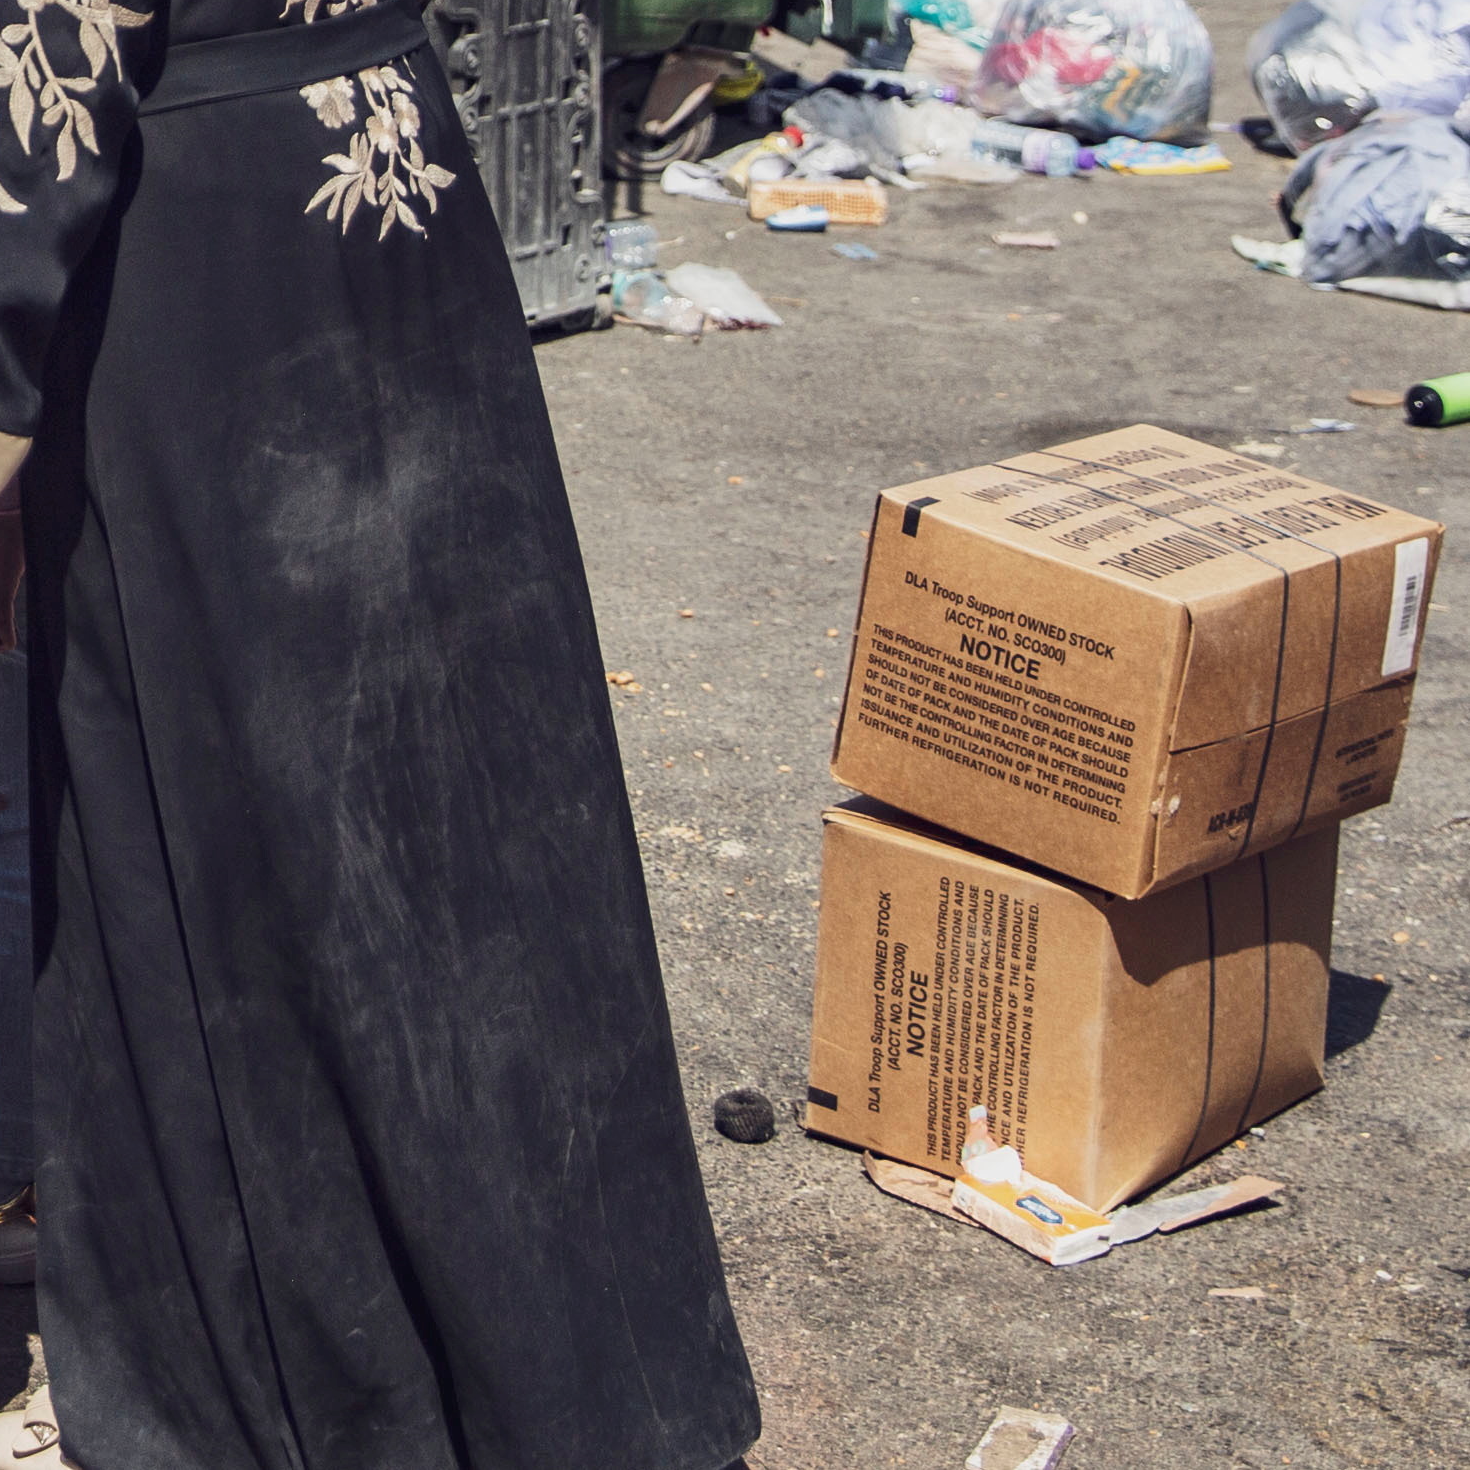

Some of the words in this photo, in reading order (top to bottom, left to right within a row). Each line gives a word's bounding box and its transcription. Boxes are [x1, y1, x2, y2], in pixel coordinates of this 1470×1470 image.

[1005, 502, 1082, 531] FROZEN
[1099, 532, 1232, 581] INDIVIDUAL
[904, 570, 929, 592] DLA
[931, 580, 964, 608] Troop
[965, 594, 1016, 627] Support
[1017, 613, 1067, 642] OWNED
[1068, 632, 1116, 661] STOCK
[944, 607, 985, 634] (ACCT.
[987, 623, 1010, 643] NO.
[873, 623, 894, 641] THIS
[895, 633, 943, 660] PRODUCT
[942, 652, 964, 669] HAS
[965, 661, 994, 680] BEEN
[994, 672, 1023, 691] HELD
[1024, 684, 1062, 706] UNDER
[1063, 698, 1136, 733] CONTROLLED
[959, 633, 1042, 681] NOTICE
[867, 653, 908, 678] SHOULD
[909, 671, 931, 687] NOT
[932, 680, 947, 695] BE
[948, 687, 1019, 721] CONSIDERED
[1020, 714, 1050, 734] OVER
[1051, 727, 1076, 744] AGE
[1077, 736, 1132, 764] BECAUSE
[871, 638, 946, 678] TEMPERATURE
[947, 671, 972, 688] AND
[974, 681, 1030, 710] HUMIDITY
[1032, 703, 1105, 738] CONDITIONS
[1107, 731, 1134, 748] AND
[862, 682, 883, 699] NOT
[884, 692, 898, 706] BE
[899, 698, 919, 715] THE
[919, 707, 992, 744] CONTROLLING
[993, 736, 1036, 761] FACTOR
[1037, 753, 1049, 766] IN
[1050, 758, 1126, 795] DETERMINING
[865, 668, 879, 681] OF
[880, 674, 906, 694] DATE
[907, 686, 923, 699] OF
[923, 692, 951, 712] PACK
[952, 705, 977, 721] AND
[978, 713, 1000, 731] THE
[1001, 723, 1030, 743] DATE
[1031, 735, 1048, 748] OF
[1049, 741, 1079, 761] PACK
[1081, 753, 1129, 779] SHOULD
[858, 711, 909, 742] FURTHER
[911, 735, 1006, 781] REFRIGERATION
[1008, 774, 1021, 787] IS
[1023, 779, 1050, 797] NOT
[1052, 790, 1121, 825] REQUIRED.
[860, 697, 914, 728] ISSUANCE
[915, 722, 940, 739] AND
[943, 732, 1013, 767] UTILIZATION
[1015, 760, 1033, 774] OF
[1035, 767, 1059, 786] THE
[1062, 778, 1123, 810] PRODUCT.
[876, 890, 892, 938] STOCK
[936, 876, 950, 950] CONTROLLED
[954, 880, 965, 907] AND
[967, 884, 980, 939] BECAUSE
[982, 888, 994, 937] SHOULD
[949, 909, 963, 984] CONDITIONS
[995, 893, 1009, 971] DETERMINING
[1011, 898, 1024, 960] PRODUCT.
[1025, 902, 1039, 972] REQUIRED.
[873, 939, 888, 992] OWNED
[934, 951, 945, 991] UNDER
[965, 941, 976, 966] AGE
[980, 938, 991, 971] PACK
[1009, 963, 1021, 987] THE
[963, 966, 974, 999] OVER
[978, 971, 989, 988] OF
[994, 971, 1004, 985] IN
[1008, 991, 1018, 1009] OF
[1024, 974, 1036, 1003] NOT
[870, 993, 887, 1046] Support
[889, 1001, 903, 1025] NO.
[906, 970, 929, 1058] NOTICE
[932, 992, 943, 1023] HELD
[946, 985, 958, 1046] HUMIDITY
[977, 990, 988, 1021] DATE
[991, 985, 1003, 1031] FACTOR
[1022, 1005, 1034, 1019] IS
[887, 1027, 901, 1071] (ACCT.
[930, 1023, 941, 1054] BEEN
[959, 1000, 972, 1075] CONSIDERED
[975, 1022, 986, 1044] THE
[1003, 1011, 1017, 1087] UTILIZATION
[868, 1047, 886, 1082] Troop
[929, 1054, 939, 1078] HAS
[944, 1048, 954, 1075] AND
[974, 1047, 985, 1073] AND
[987, 1032, 1001, 1112] CONTROLLING
[1017, 1021, 1032, 1125] REFRIGERATION
[867, 1086, 881, 1114] DLA
[927, 1078, 938, 1132] PRODUCT
[957, 1077, 968, 1093] BE
[957, 1094, 967, 1120] NOT
[972, 1073, 983, 1105] PACK
[1002, 1090, 1013, 1118] AND
[940, 1076, 953, 1162] TEMPERATURE
[926, 1132, 937, 1157] THIS
